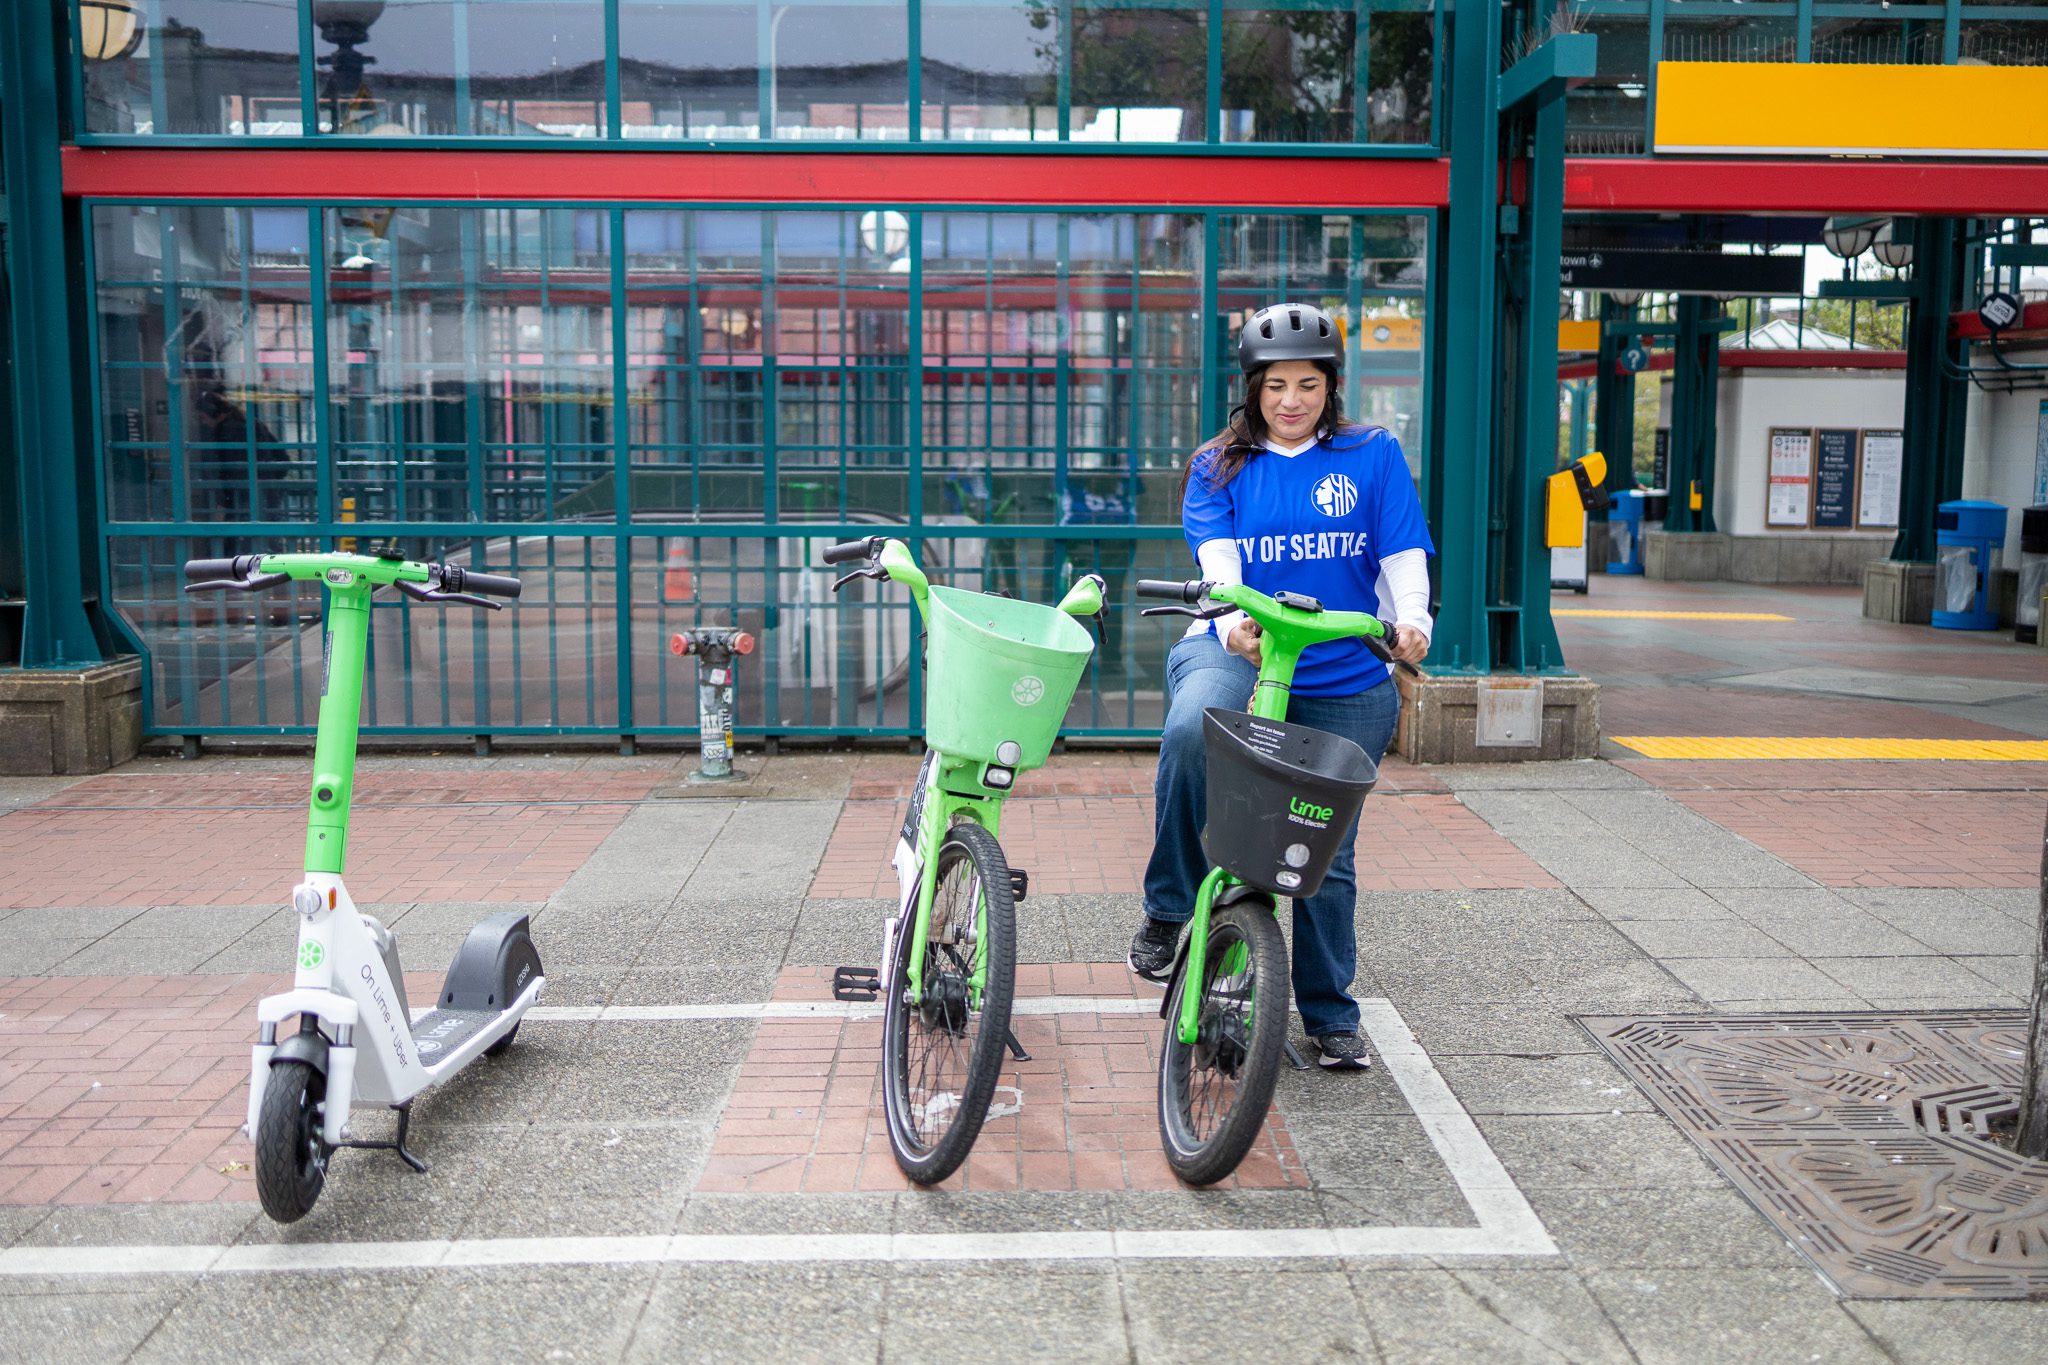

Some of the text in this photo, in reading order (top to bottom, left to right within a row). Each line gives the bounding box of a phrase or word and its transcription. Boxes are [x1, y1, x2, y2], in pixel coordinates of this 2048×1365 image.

[1260, 534, 1286, 563] OF
[1290, 531, 1367, 561] SEATTLE
[1288, 813, 1328, 829] 100% Electric
[1290, 796, 1334, 821] Lime
[360, 964, 376, 989] On
[373, 986, 391, 1023] Lime
[393, 1036, 409, 1069] Uber
[420, 1018, 465, 1039] Lime
